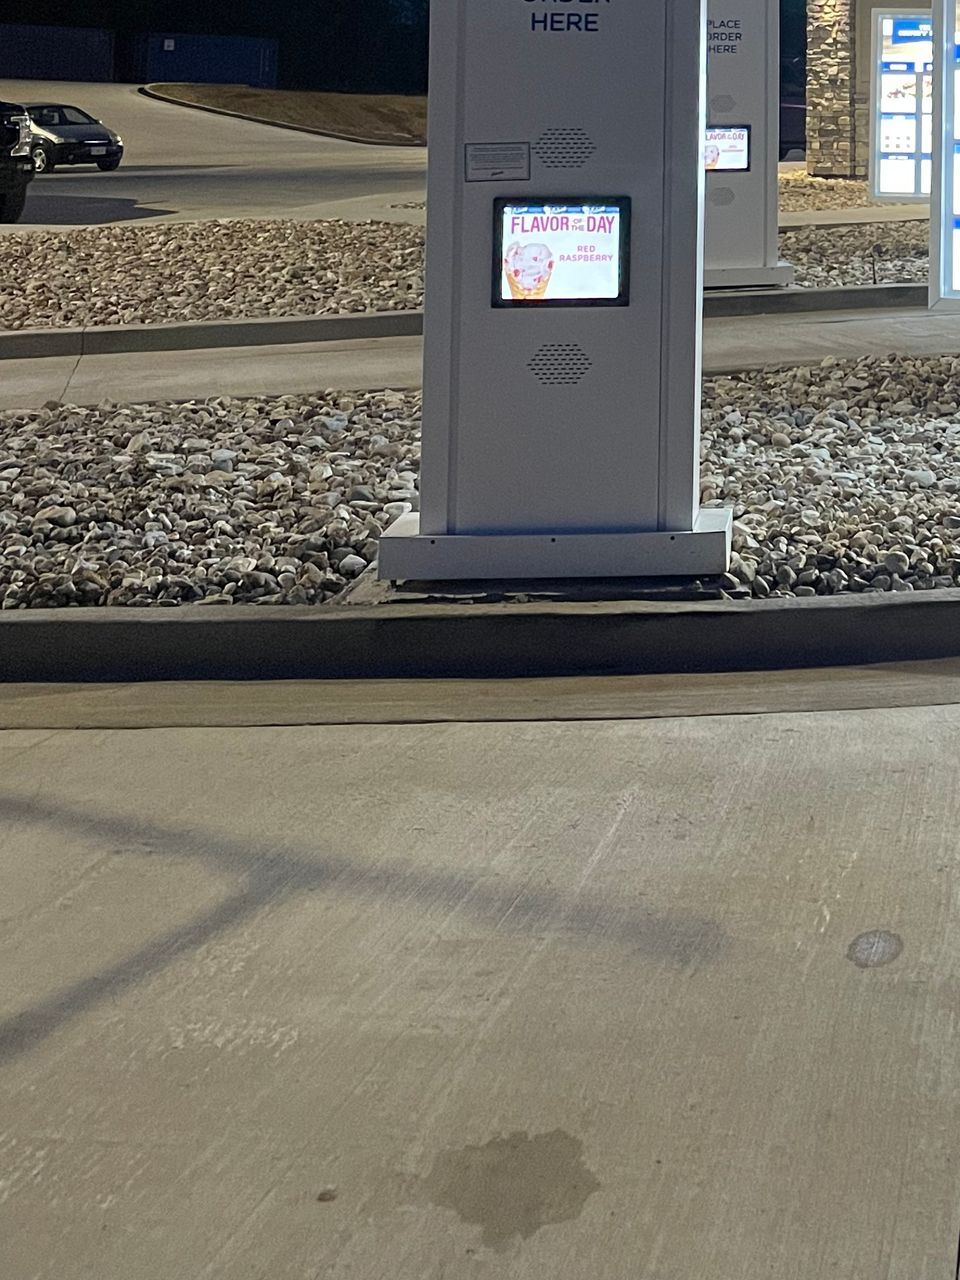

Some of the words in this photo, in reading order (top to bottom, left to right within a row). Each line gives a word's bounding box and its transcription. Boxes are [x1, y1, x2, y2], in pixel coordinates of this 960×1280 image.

[531, 12, 599, 32] HERE
[708, 45, 737, 54] HERE
[511, 216, 570, 234] FLAVOR
[587, 216, 615, 234] DAY
[577, 245, 596, 253] RED
[559, 254, 614, 262] RASPBERRY
